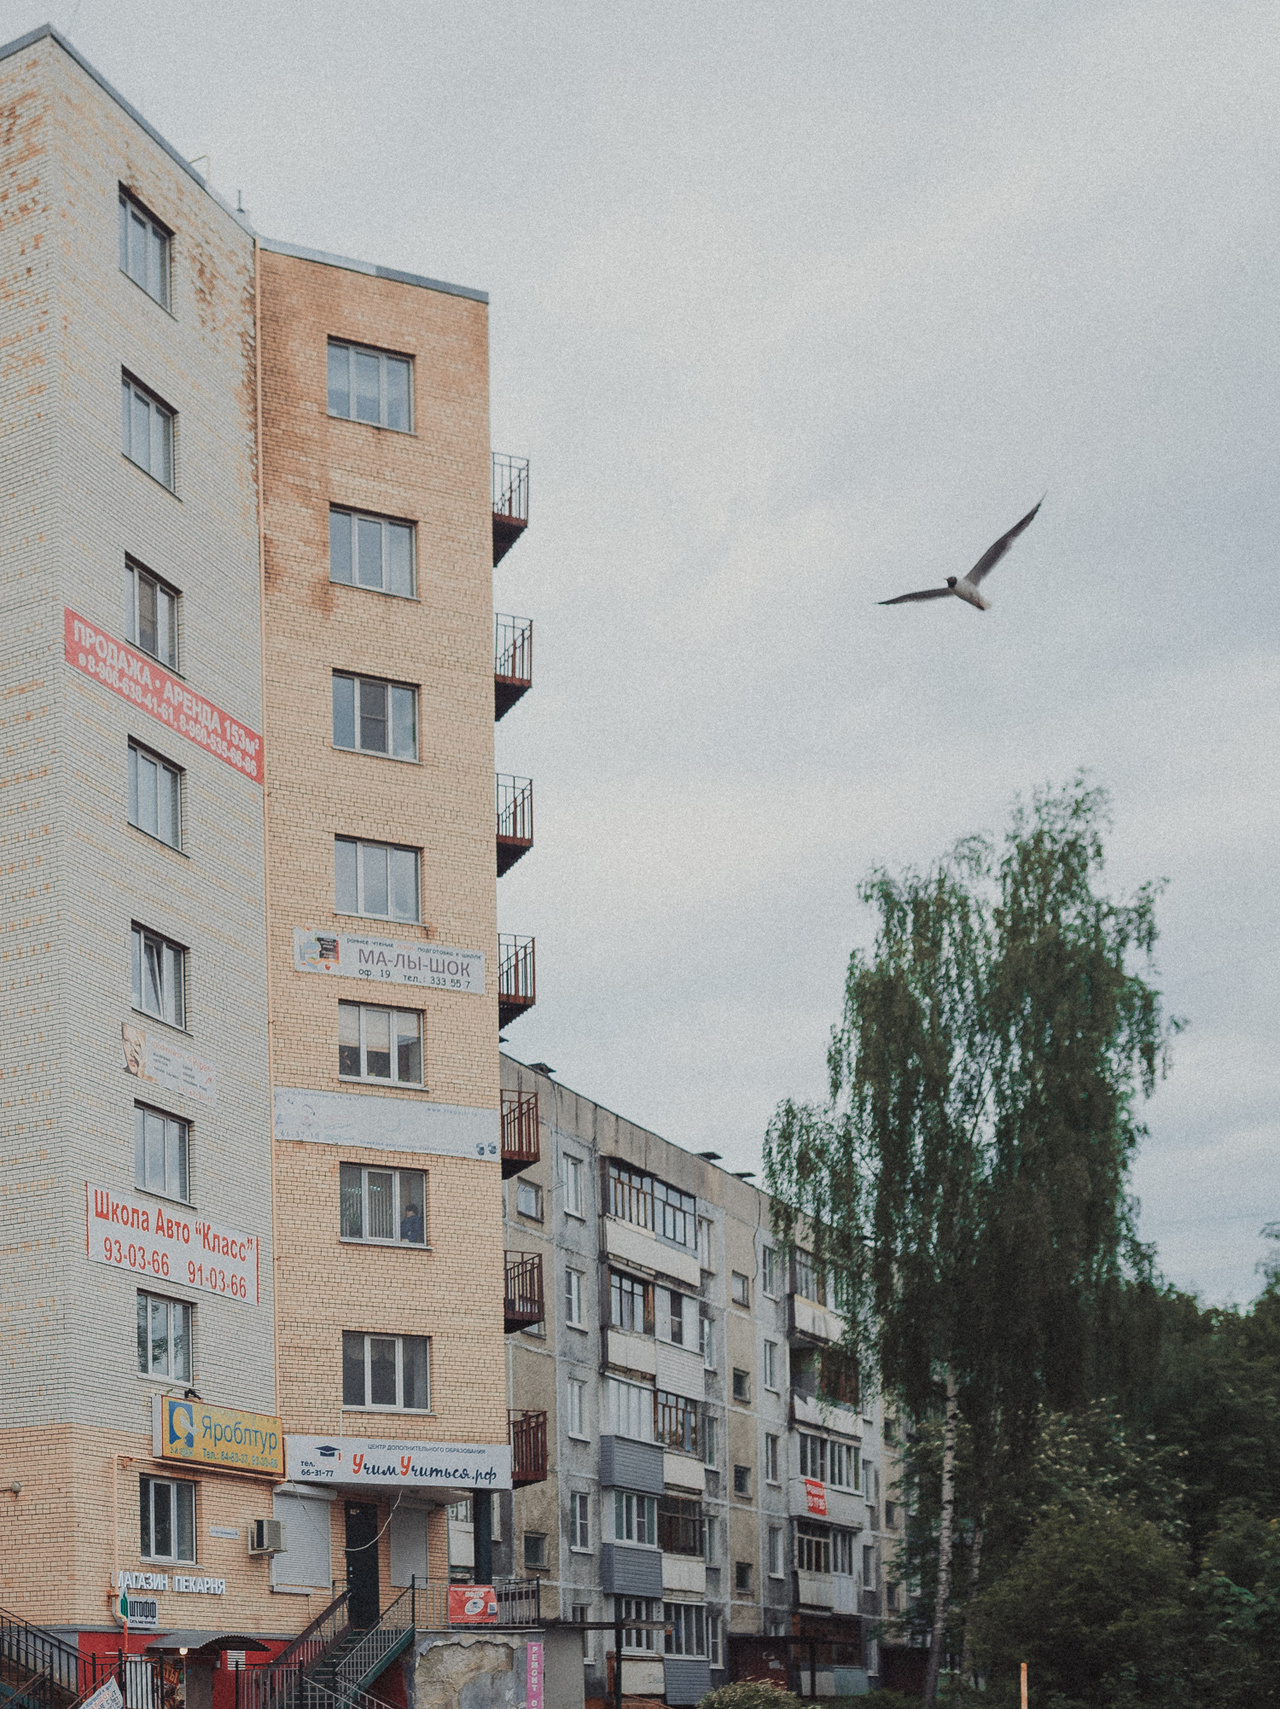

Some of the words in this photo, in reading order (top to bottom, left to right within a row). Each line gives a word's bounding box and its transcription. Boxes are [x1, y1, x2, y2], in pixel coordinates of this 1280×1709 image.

[74, 620, 152, 690] ПРОДАЖА
[163, 680, 221, 734] АРЕНДА
[358, 949, 471, 977] МА-ЛЫ-ШОК
[358, 969, 375, 979] оф.
[380, 969, 391, 978] 19
[430, 976, 447, 986] 333
[450, 979, 461, 988] 55
[465, 981, 471, 989] 7
[94, 1189, 150, 1232] Школа
[155, 1208, 190, 1244] Авто
[104, 1236, 170, 1276] 93-03-66
[187, 1260, 247, 1299] 91-03-66
[202, 1415, 277, 1455] Яроблтур
[387, 1444, 444, 1452] ДОПОЛНИТЕЛЬНОГО
[301, 1468, 334, 1477] 66-31-77
[173, 1575, 226, 1594] ПЕКАРНЯ
[531, 1646, 539, 1692] РЕМОНТ
